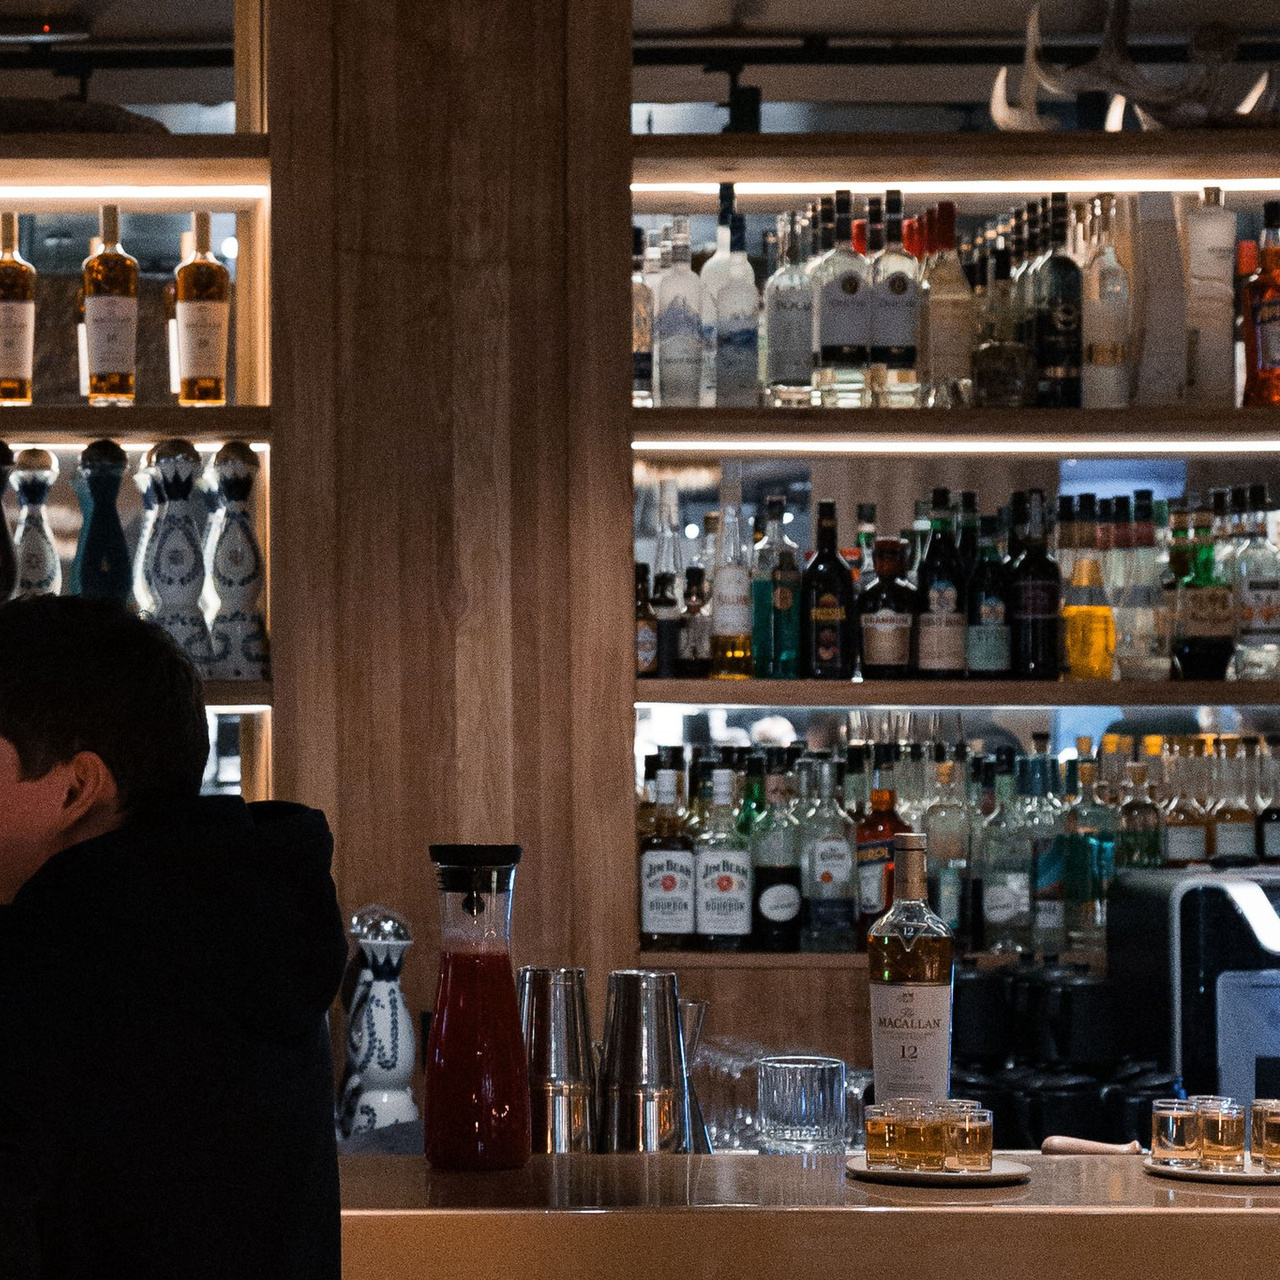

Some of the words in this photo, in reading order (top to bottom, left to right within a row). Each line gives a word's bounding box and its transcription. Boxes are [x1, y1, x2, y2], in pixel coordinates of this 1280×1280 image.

[647, 863, 665, 878] JIM
[666, 859, 692, 877] BEAM
[703, 863, 721, 879] JIM
[722, 859, 748, 878] BEAM
[902, 926, 915, 936] 12
[878, 1016, 941, 1029] MACALLAN
[900, 1046, 919, 1059] 12
